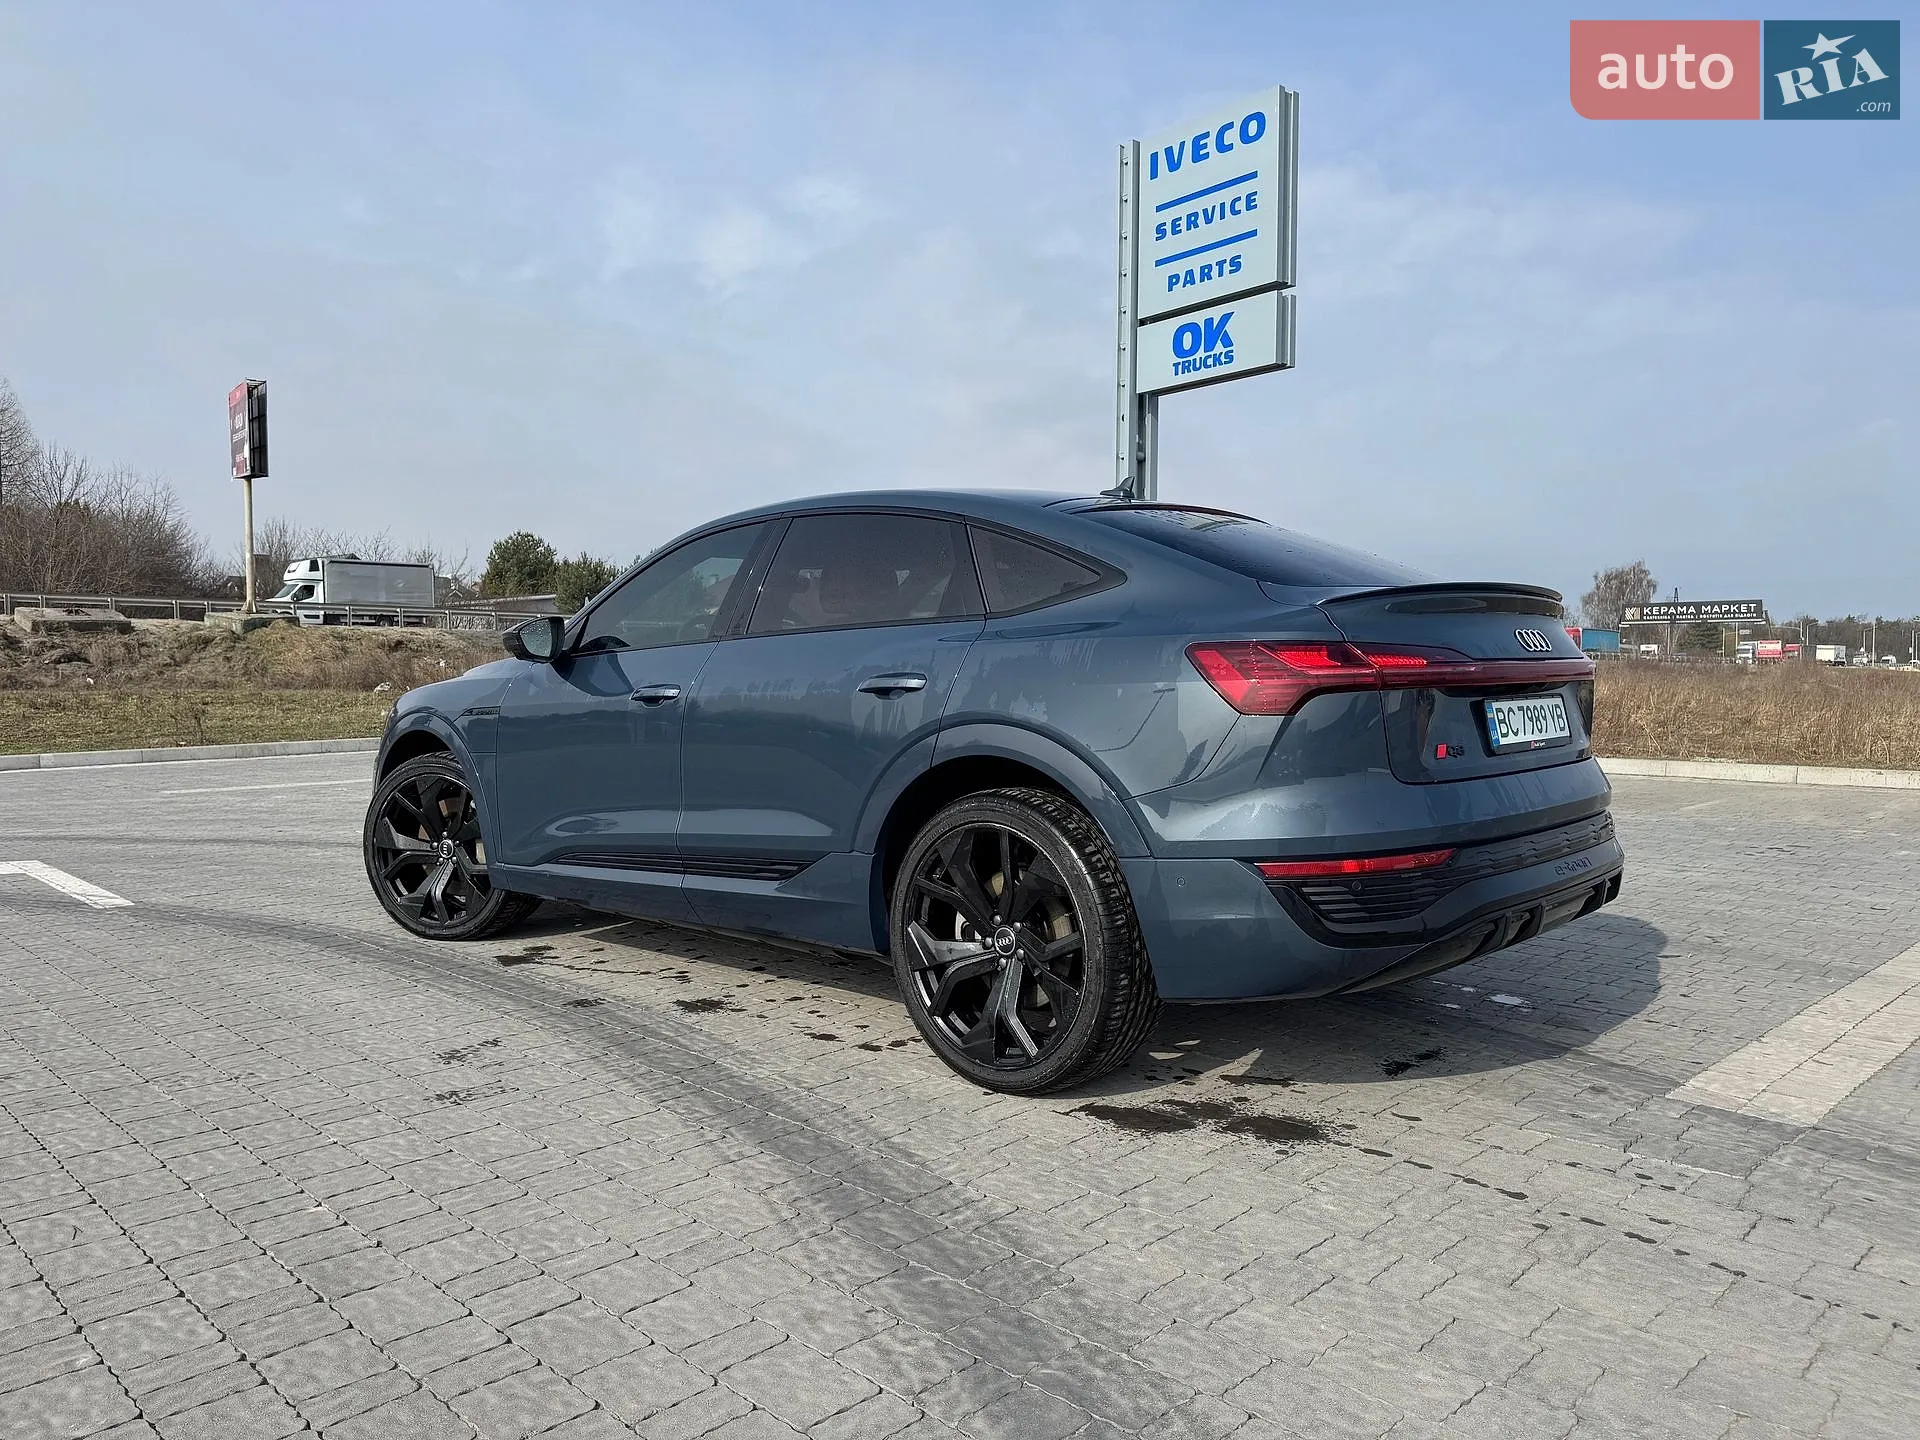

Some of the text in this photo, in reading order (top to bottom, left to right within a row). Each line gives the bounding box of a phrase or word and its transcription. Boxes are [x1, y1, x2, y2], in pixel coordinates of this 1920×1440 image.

[1149, 111, 1267, 181] IVECO
[1154, 190, 1258, 242] SERVICE
[1167, 254, 1243, 293] PARTS
[1172, 311, 1235, 359] OK
[1172, 350, 1235, 377] TRUCKS
[1643, 603, 1757, 615] КЕРАМА МАРКЕТ
